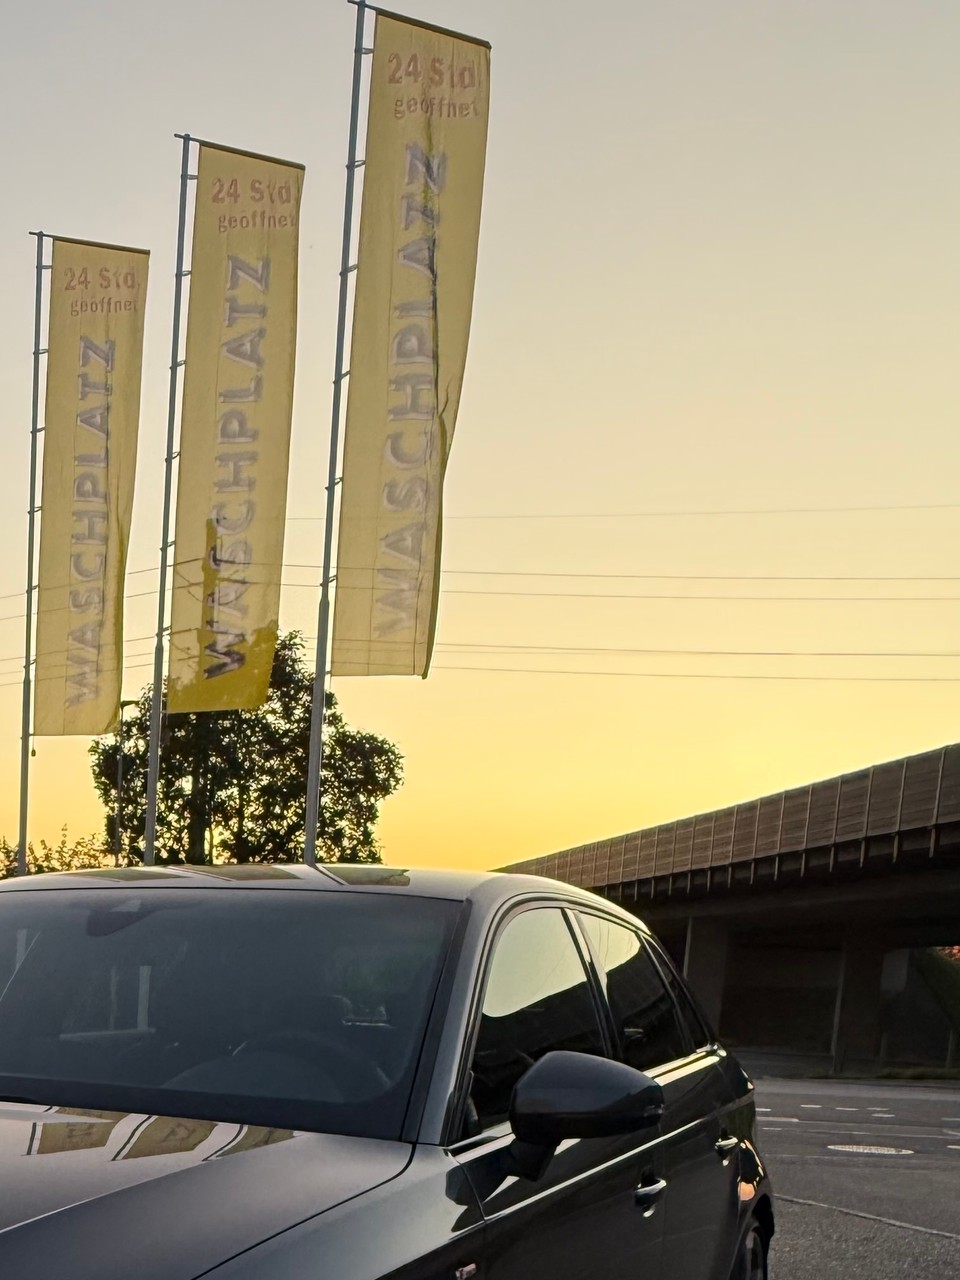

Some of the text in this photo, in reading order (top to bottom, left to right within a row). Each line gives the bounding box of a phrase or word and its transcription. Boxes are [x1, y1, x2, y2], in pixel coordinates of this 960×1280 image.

[387, 52, 421, 84] 24
[212, 178, 240, 204] 24
[64, 267, 91, 291] 24
[203, 254, 271, 679] WASCHPLATZ
[64, 335, 116, 708] WASCHPLATZ
